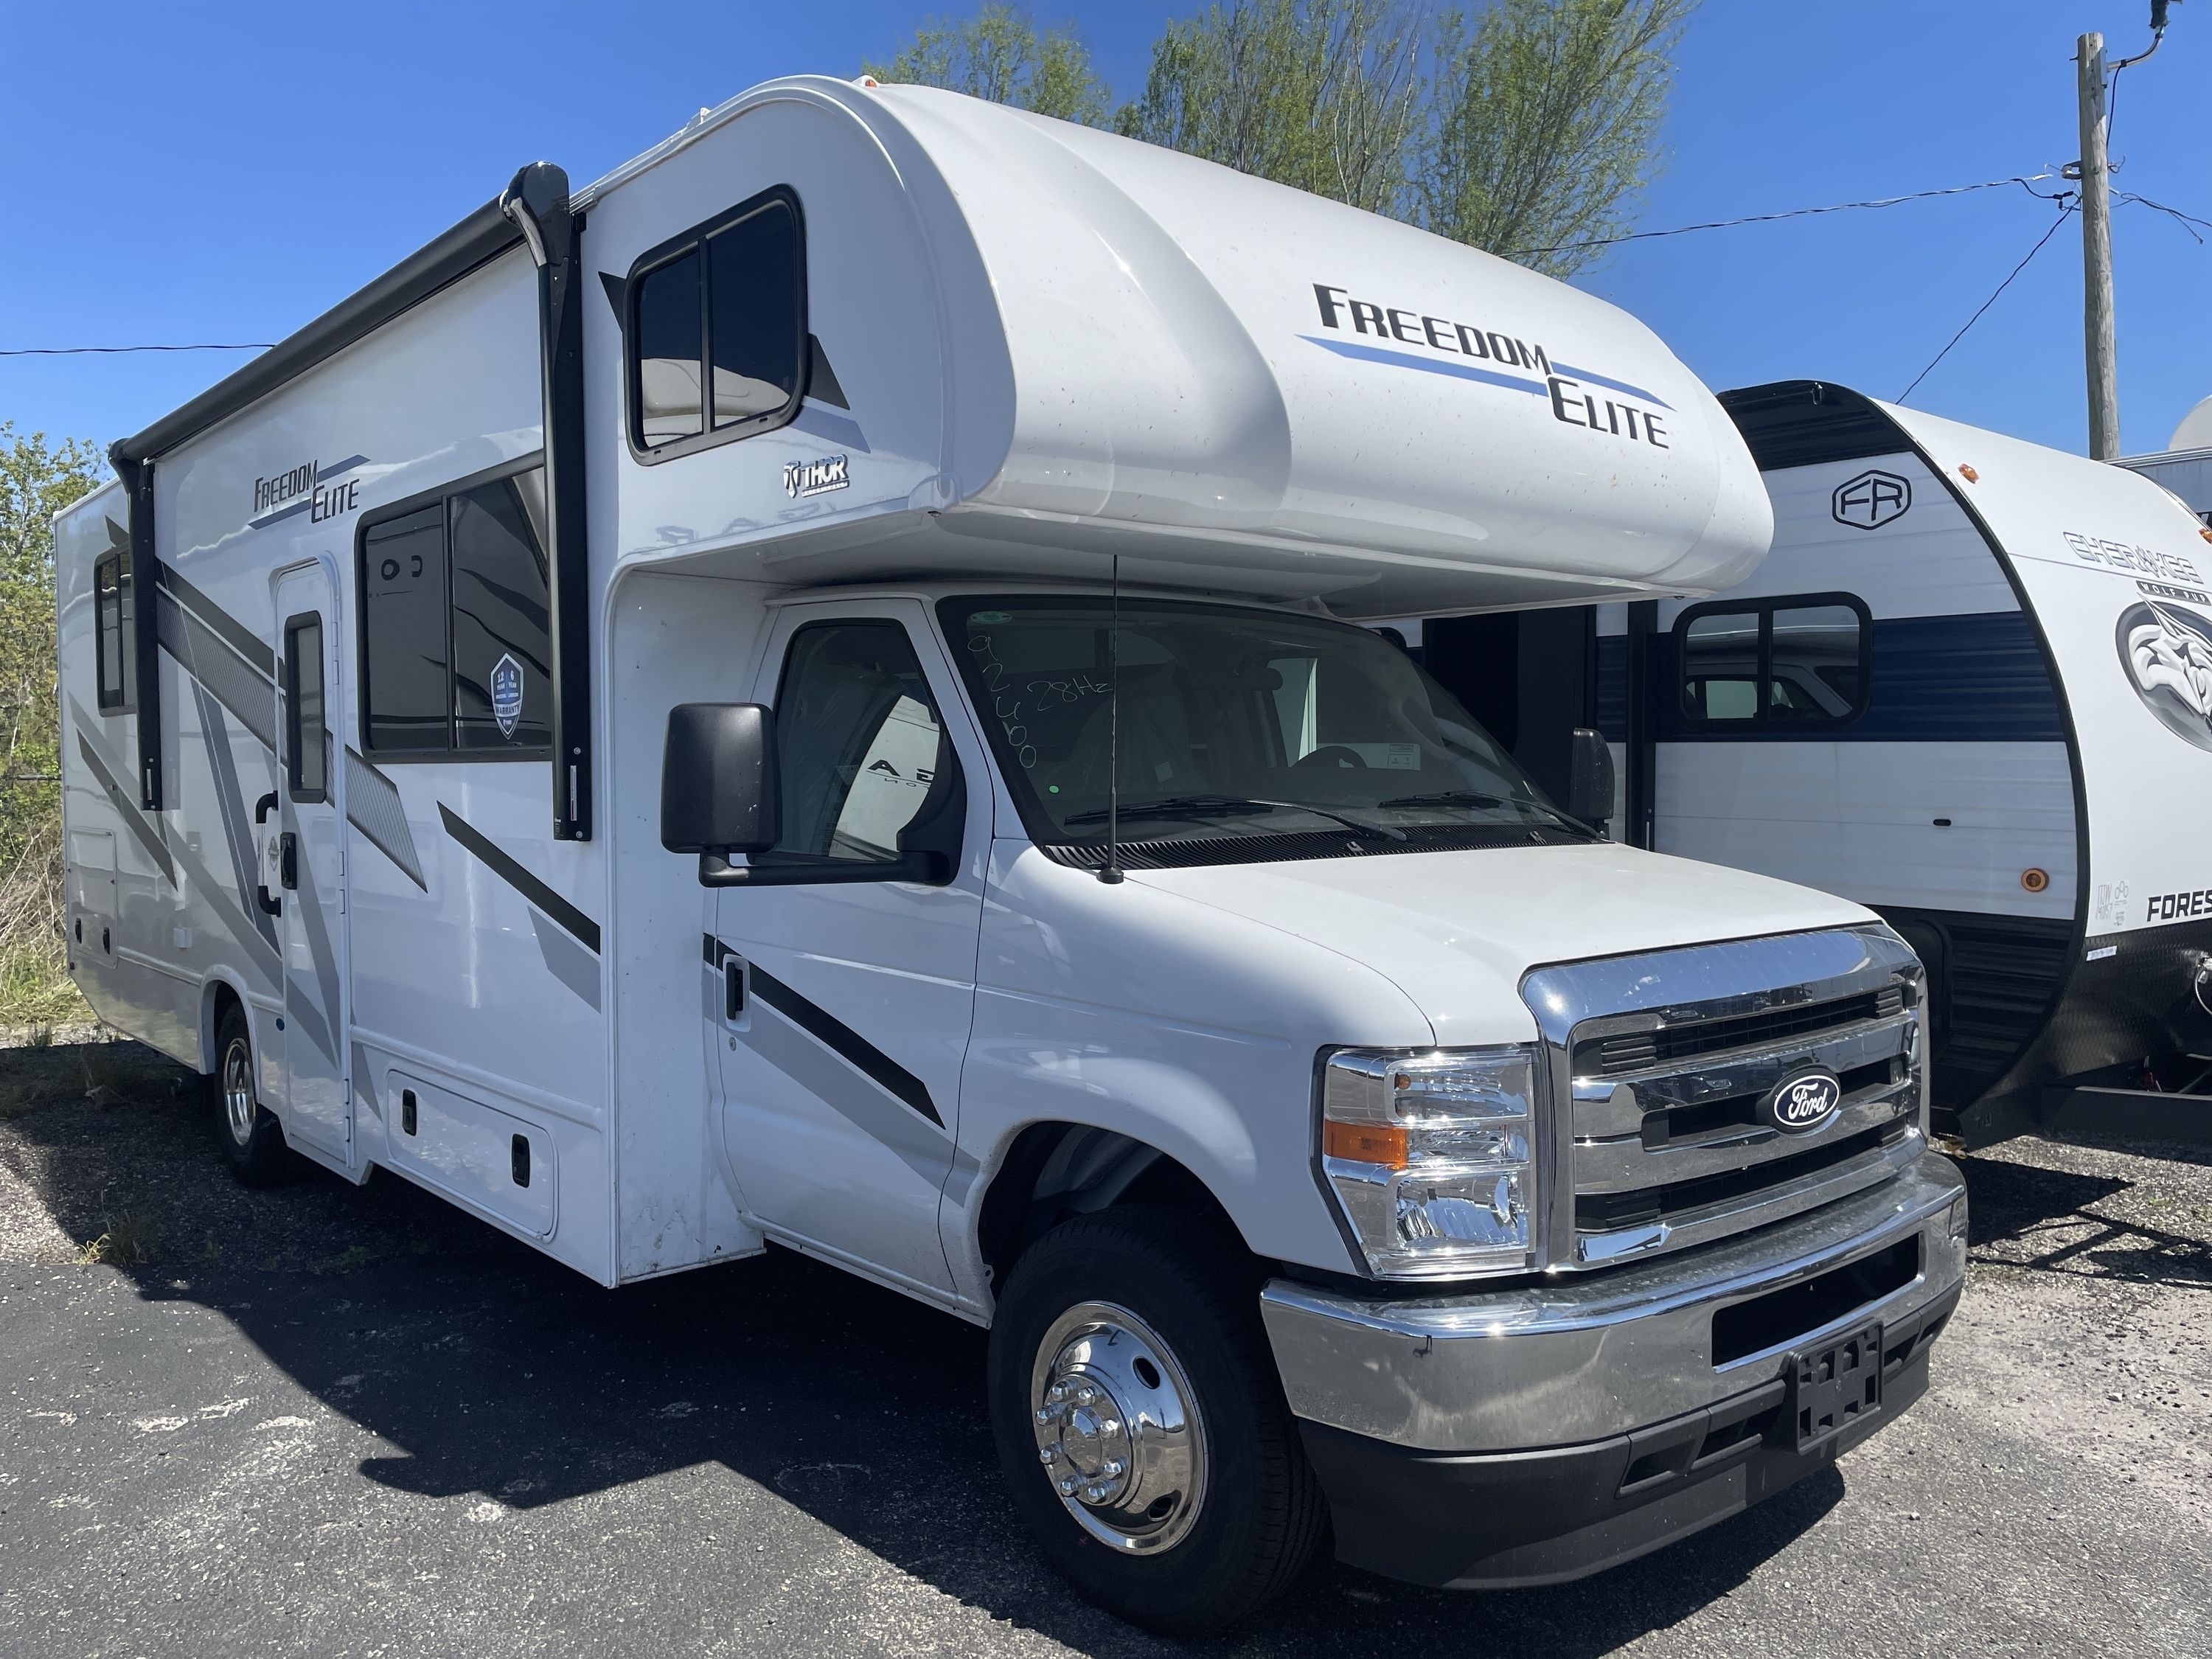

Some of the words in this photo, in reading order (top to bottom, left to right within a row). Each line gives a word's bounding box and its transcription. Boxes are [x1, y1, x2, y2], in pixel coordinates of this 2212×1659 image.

[1312, 282, 1554, 375] FREEDOM
[1548, 375, 1669, 449] ELITE
[254, 459, 319, 512] FREEDOM
[801, 453, 849, 488] THOR
[311, 479, 360, 524] ELITE
[1841, 478, 1903, 521] FR
[2063, 532, 2205, 585] CHEROKEE
[2140, 582, 2176, 598] WOLF
[2183, 591, 2206, 602] PUP
[497, 671, 504, 683] 12
[510, 669, 515, 681] 6
[1788, 1082, 1829, 1120] Ford
